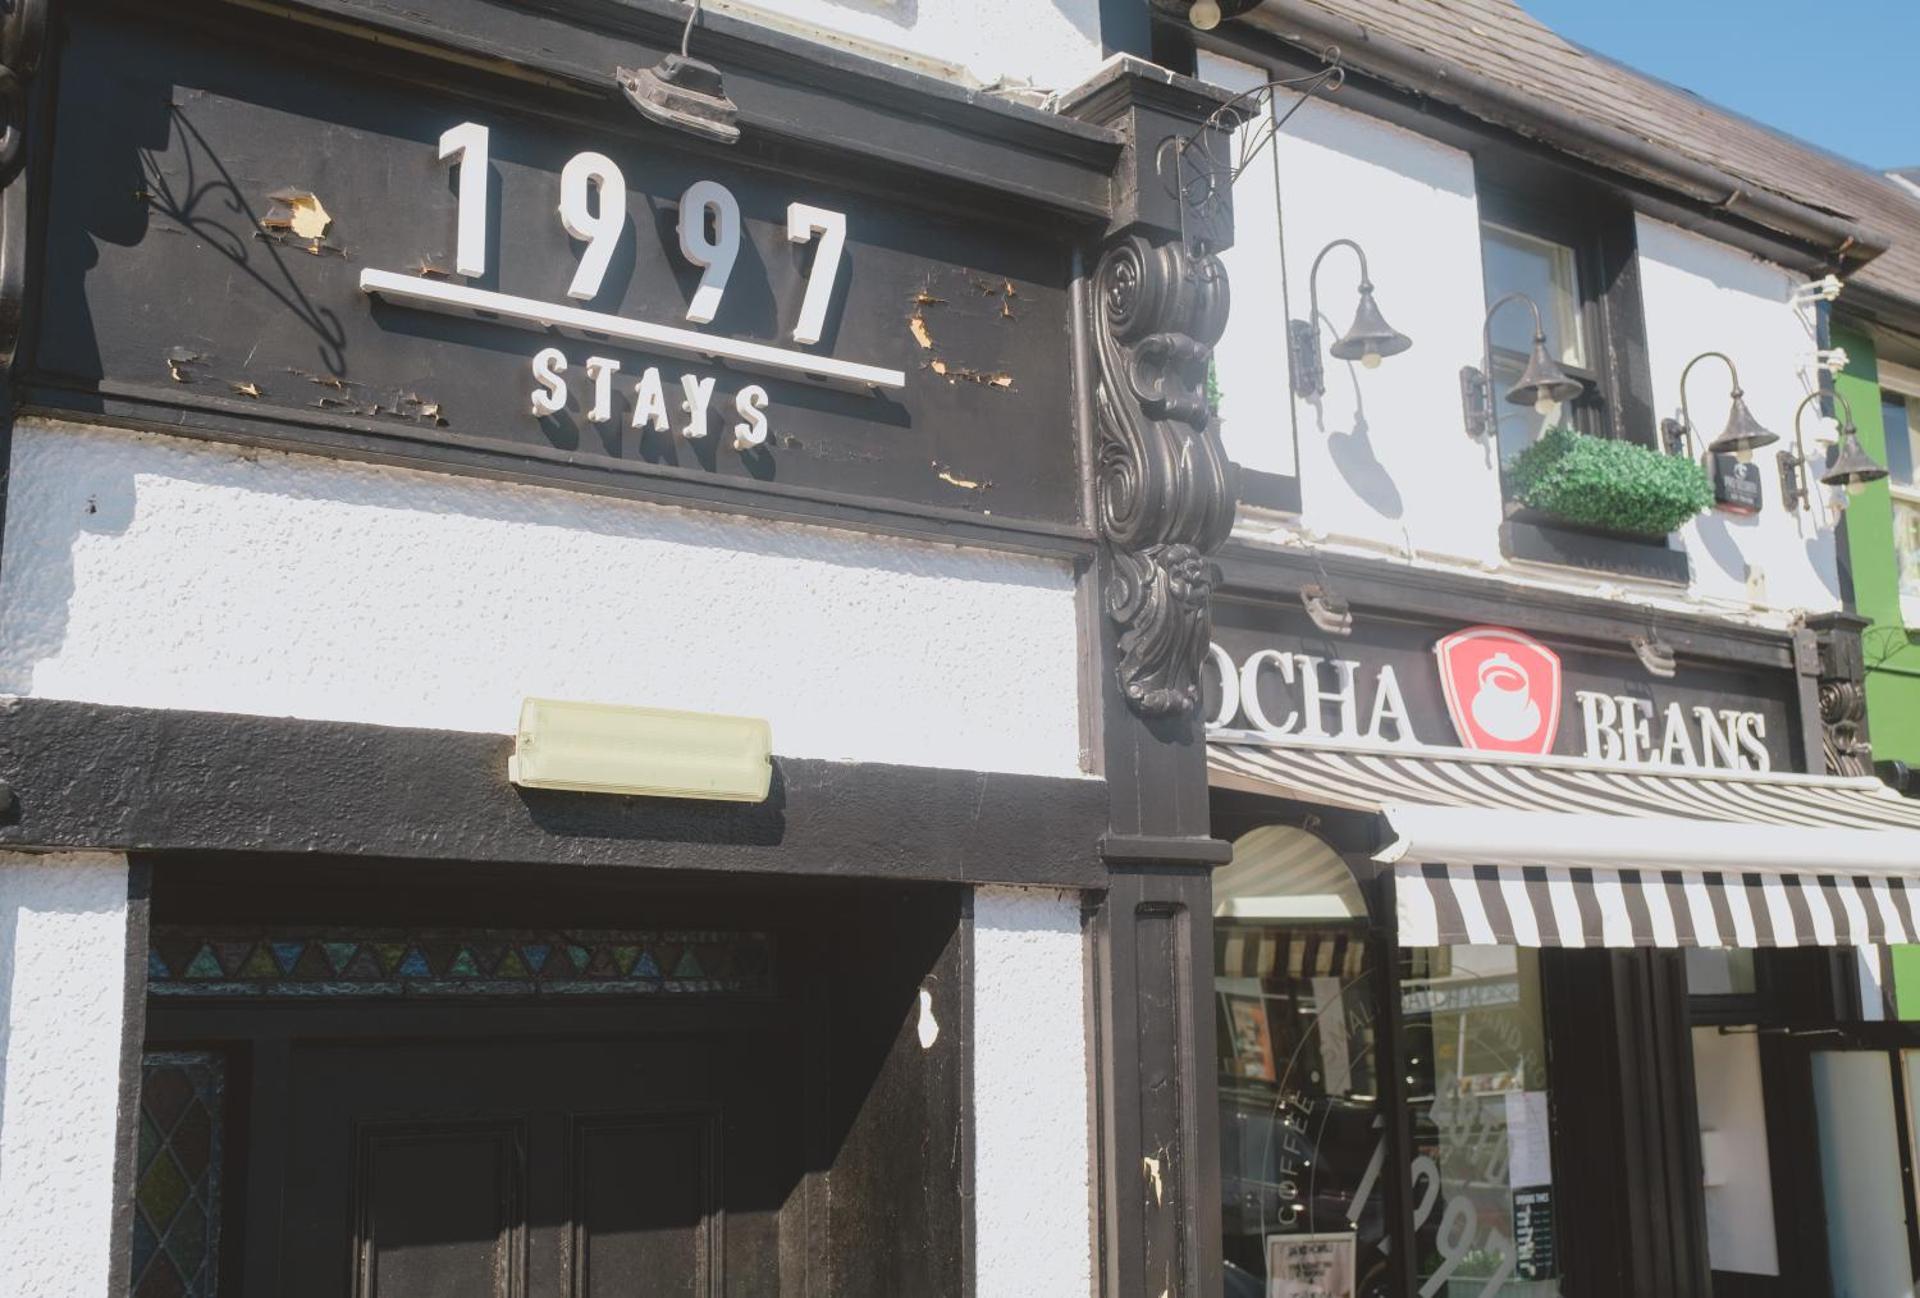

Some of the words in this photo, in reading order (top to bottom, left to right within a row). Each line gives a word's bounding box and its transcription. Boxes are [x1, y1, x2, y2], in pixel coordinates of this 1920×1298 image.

[438, 122, 847, 345] 1997
[530, 347, 770, 450] STAYS
[1576, 690, 1771, 772] BEANS
[1276, 1088, 1316, 1226] COFFEE
